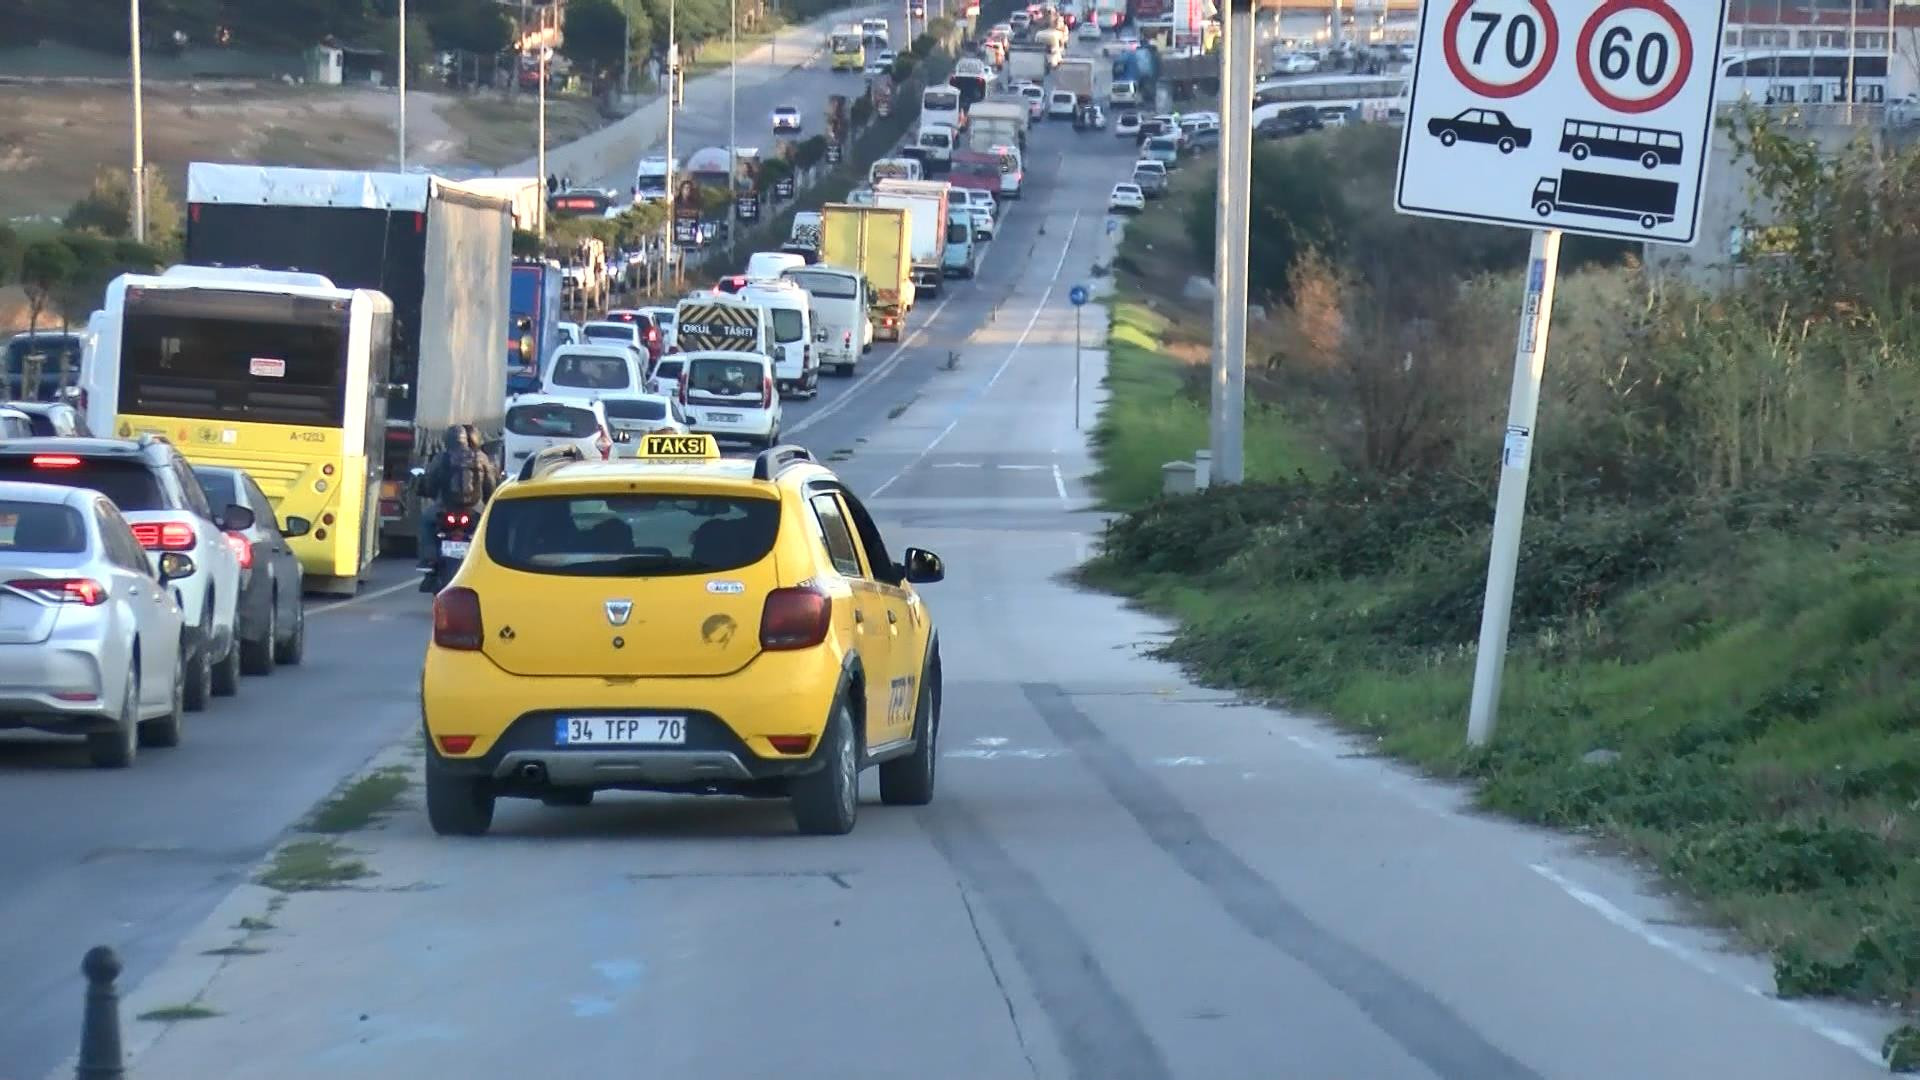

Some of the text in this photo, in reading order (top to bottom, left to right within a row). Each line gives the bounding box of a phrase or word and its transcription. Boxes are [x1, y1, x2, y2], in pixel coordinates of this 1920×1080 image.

[1470, 11, 1537, 69] 70
[1600, 26, 1669, 86] 60
[682, 324, 711, 334] OKUL
[571, 720, 680, 740] 34 TFP 70
